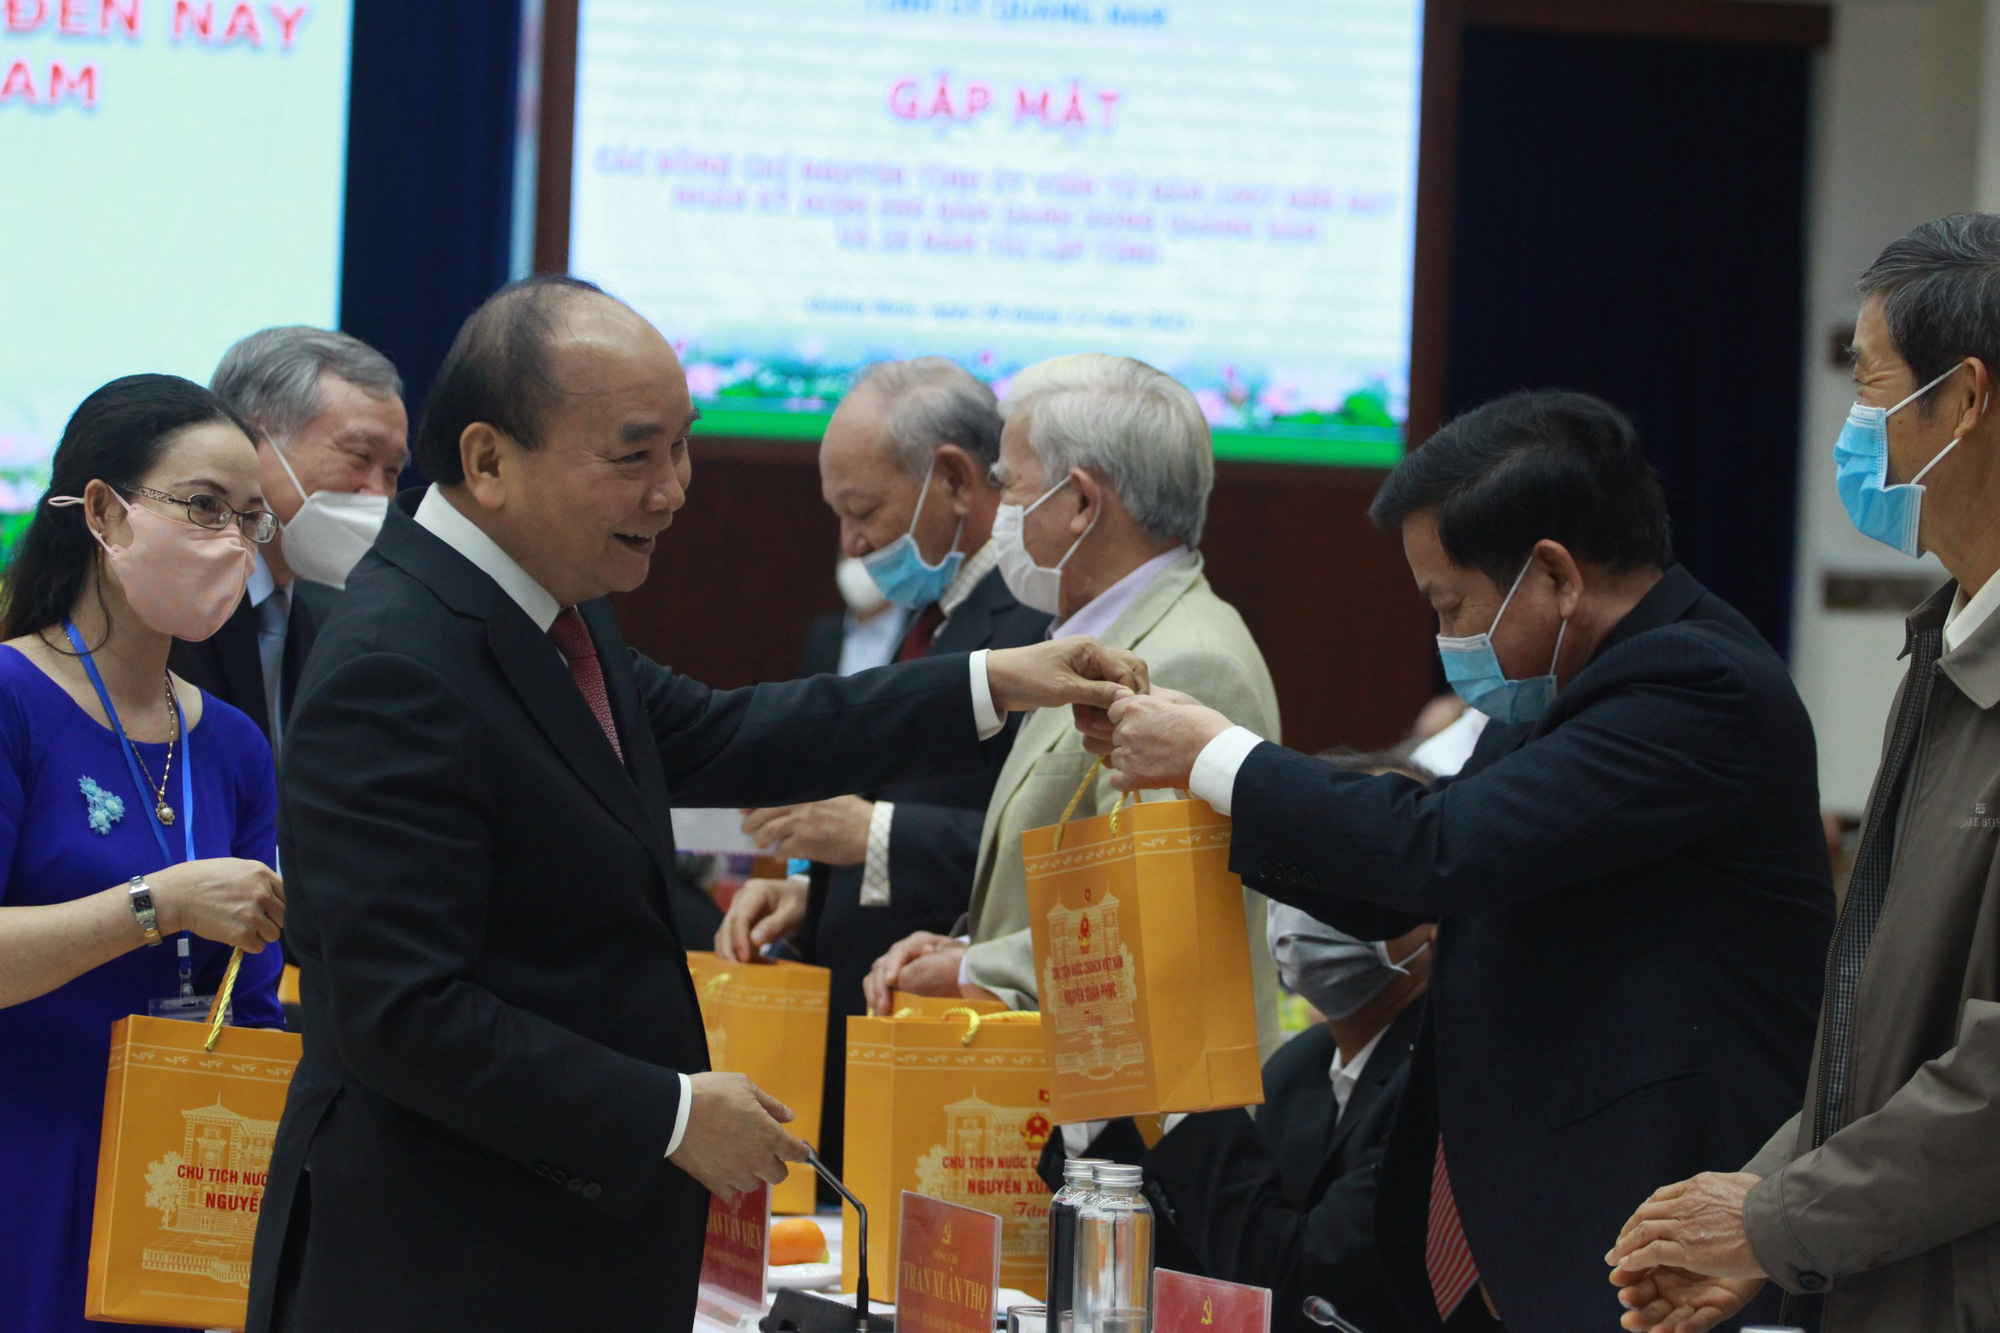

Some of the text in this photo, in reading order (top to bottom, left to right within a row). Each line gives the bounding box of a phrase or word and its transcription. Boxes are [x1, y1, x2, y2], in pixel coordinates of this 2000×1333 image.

[172, 0, 306, 47] NAY
[177, 1163, 204, 1180] CHỦ
[209, 1168, 238, 1185] TỊCH
[205, 1191, 263, 1213] NGUYỄ
[932, 1266, 962, 1304] XUÂN
[964, 1279, 987, 1320] THỌ
